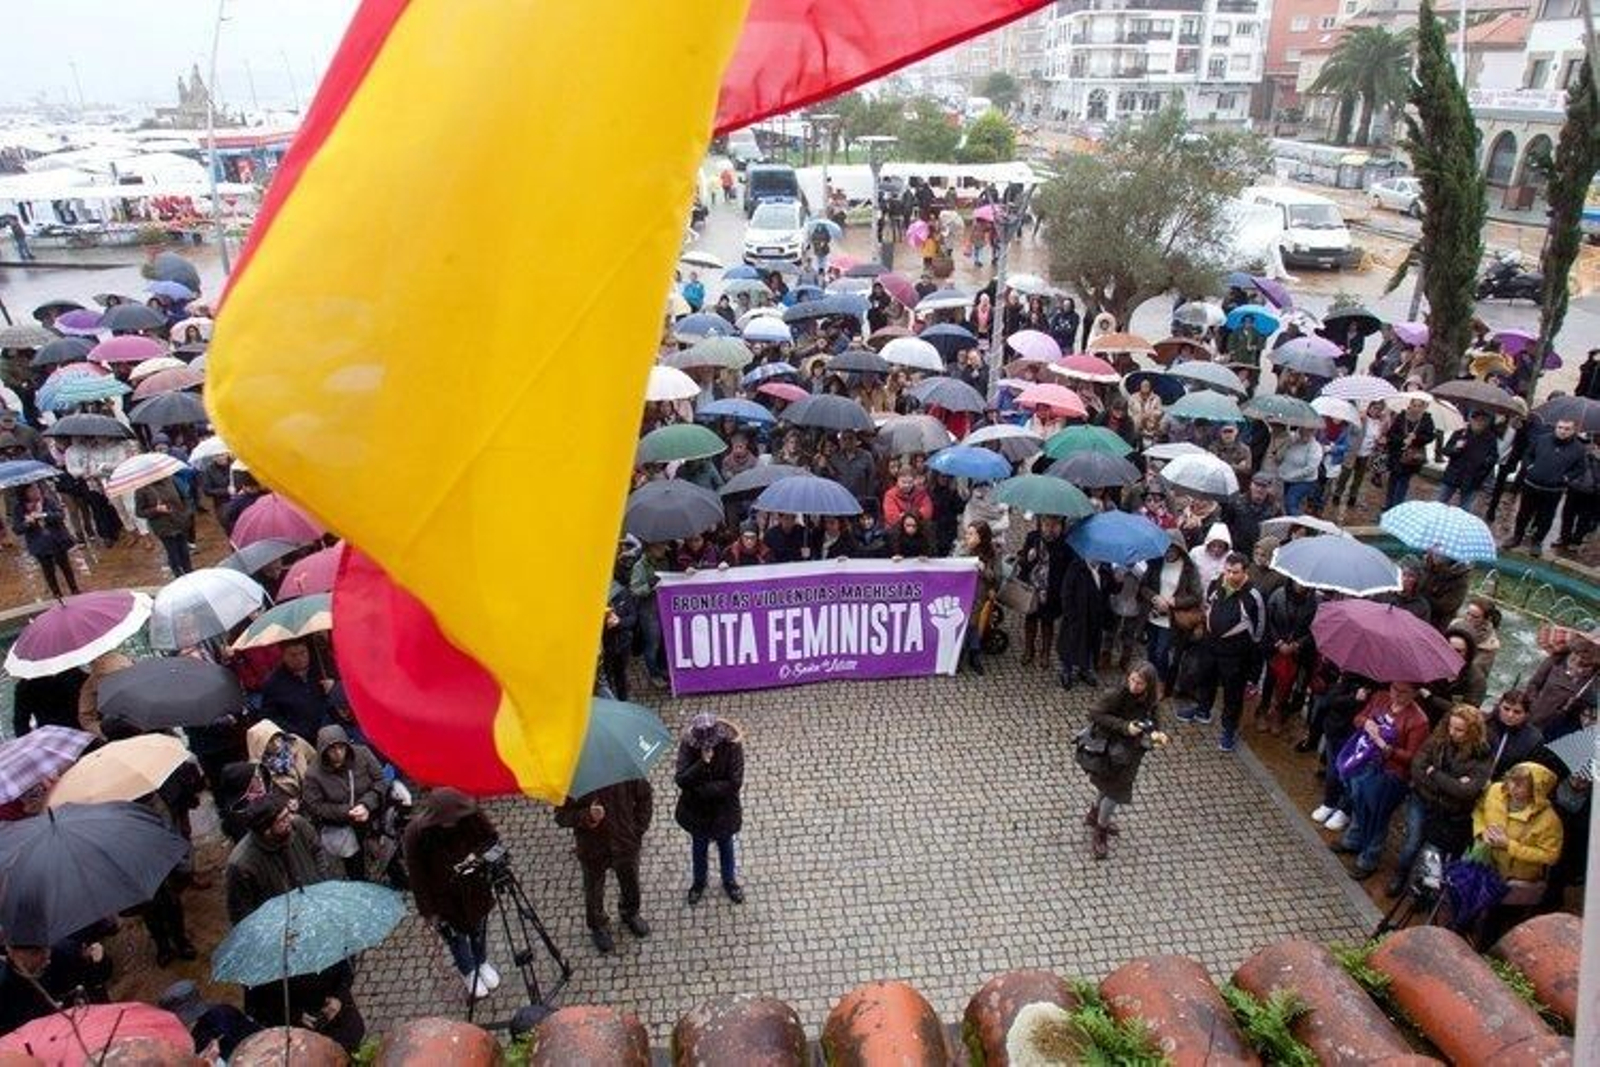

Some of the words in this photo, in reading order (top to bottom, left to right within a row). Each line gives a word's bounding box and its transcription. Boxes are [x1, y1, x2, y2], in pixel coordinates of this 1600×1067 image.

[840, 583, 923, 600] MACHISTAS
[673, 612, 759, 669] LOITA
[768, 601, 924, 662] FEMINISTA
